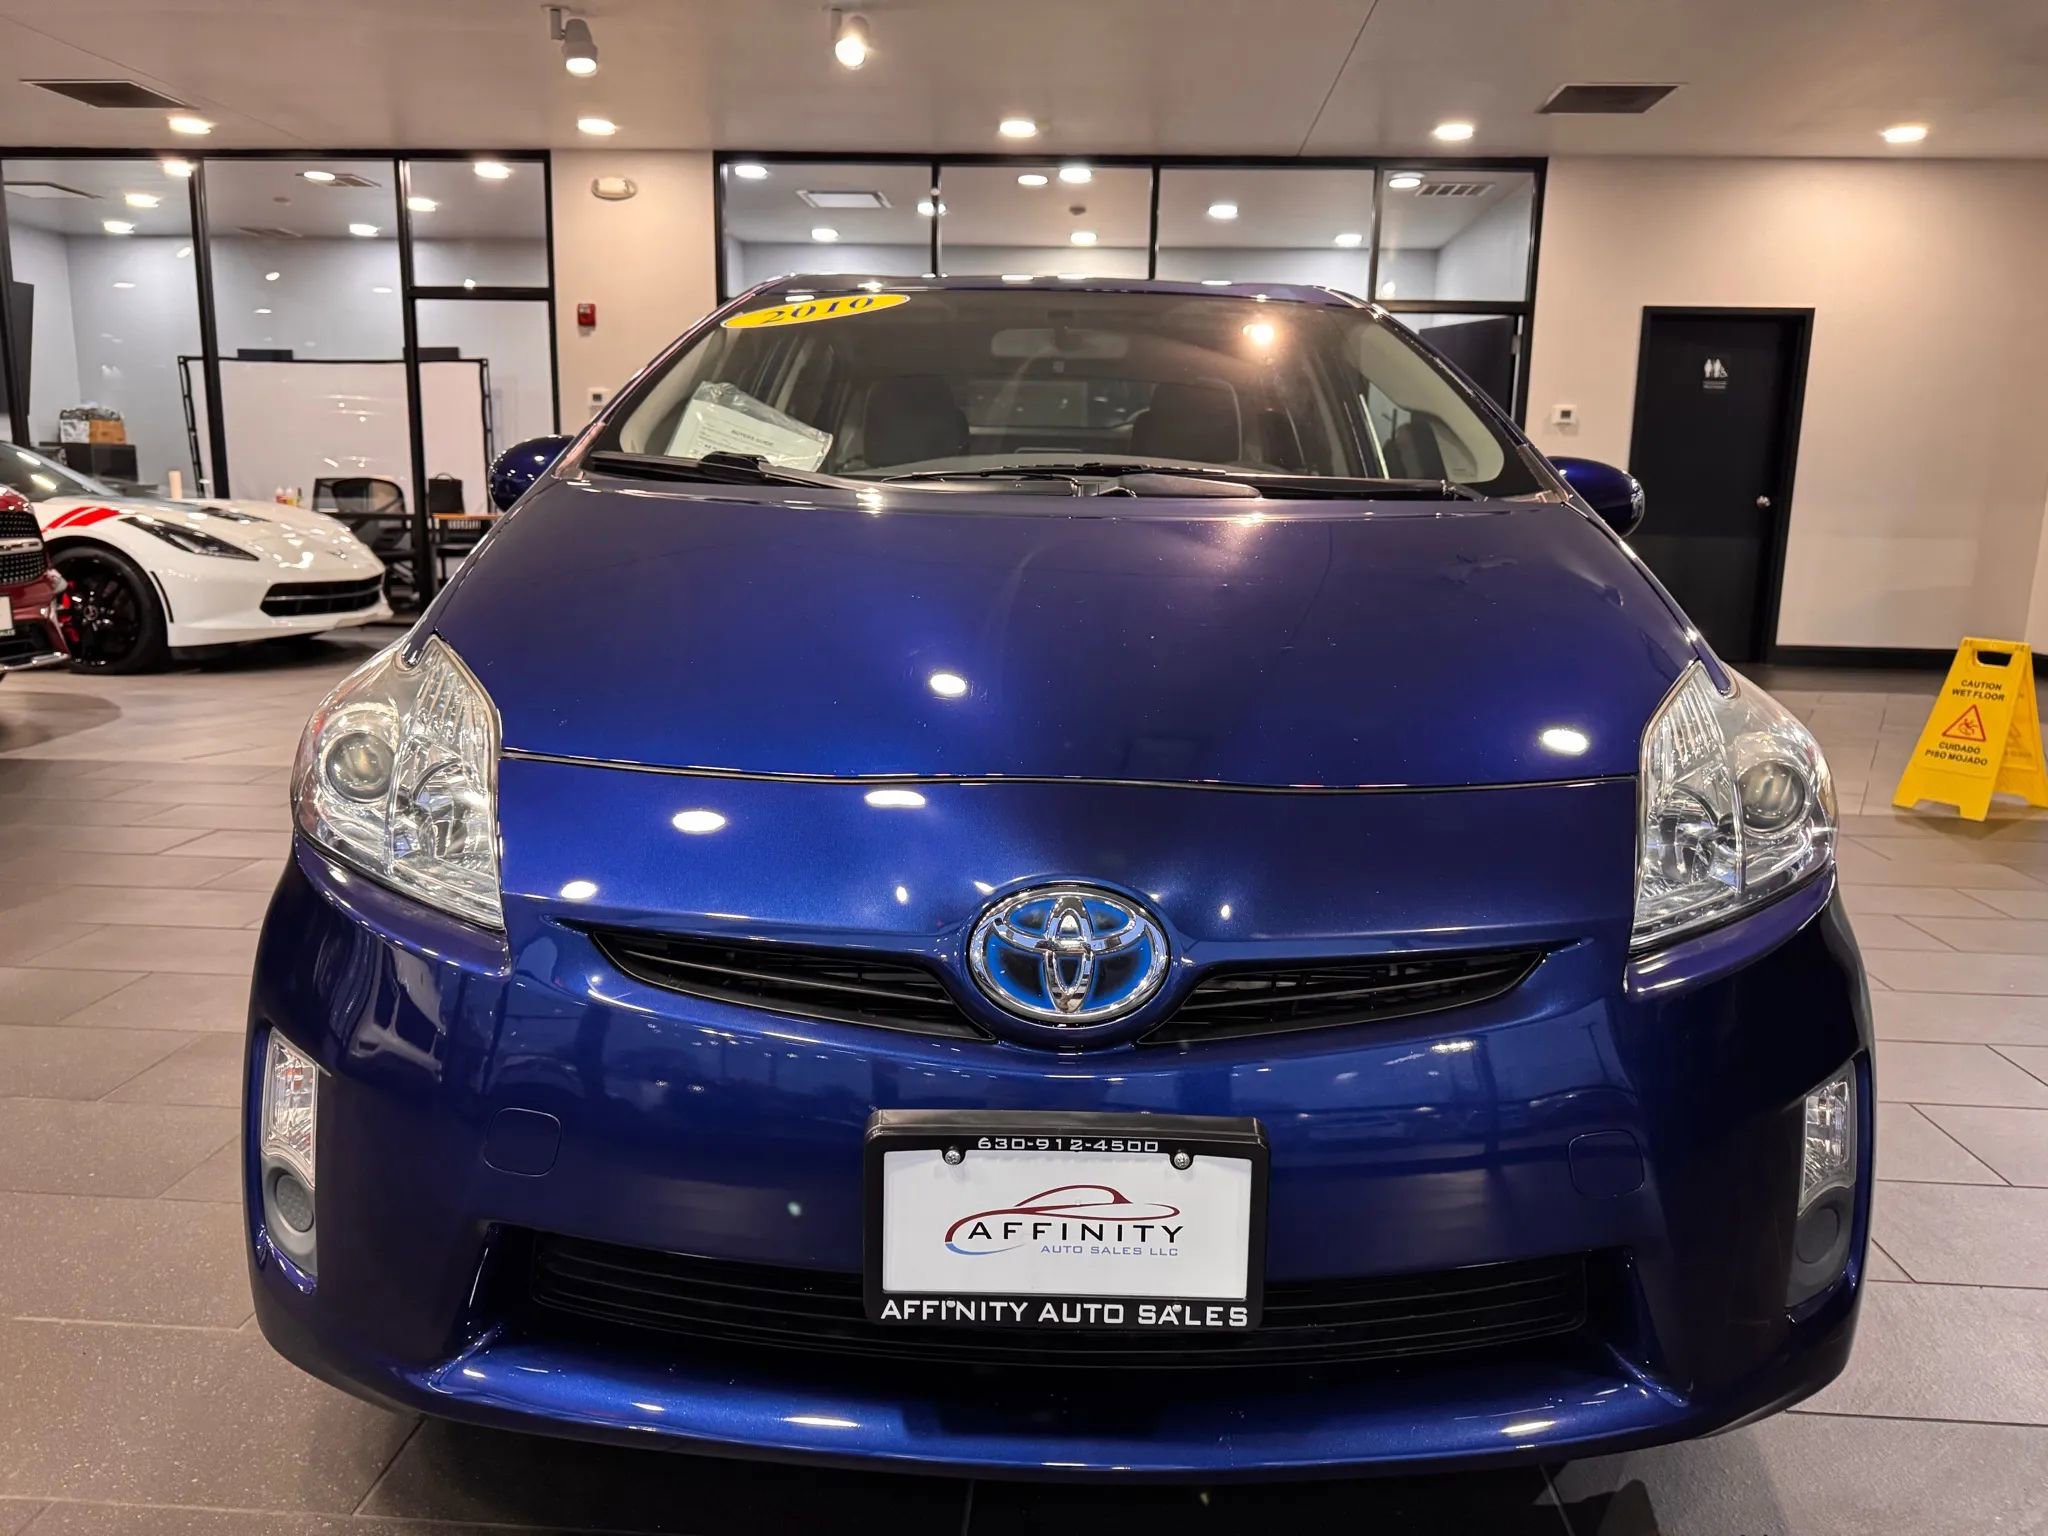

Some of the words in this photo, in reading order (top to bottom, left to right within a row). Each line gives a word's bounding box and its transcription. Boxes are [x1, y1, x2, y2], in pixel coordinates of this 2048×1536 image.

[760, 298, 874, 325] 2010
[1961, 679, 2002, 691] CAUTION
[1952, 688, 1972, 697] WET
[1972, 690, 2005, 702] FLOOR
[1938, 741, 1981, 754] CUIDADO
[1925, 749, 1947, 759] PISO
[1947, 752, 1988, 766] MOJADO
[977, 1137, 1160, 1153] 630-912-4500
[967, 1221, 1185, 1244] AFFINITY
[1040, 1244, 1084, 1255] AUTO
[1090, 1245, 1143, 1256] SALES
[1149, 1247, 1180, 1257] LLC
[880, 1299, 1030, 1322] AFFINITY
[1037, 1301, 1125, 1324] AUTO
[1137, 1303, 1249, 1327] SALES
